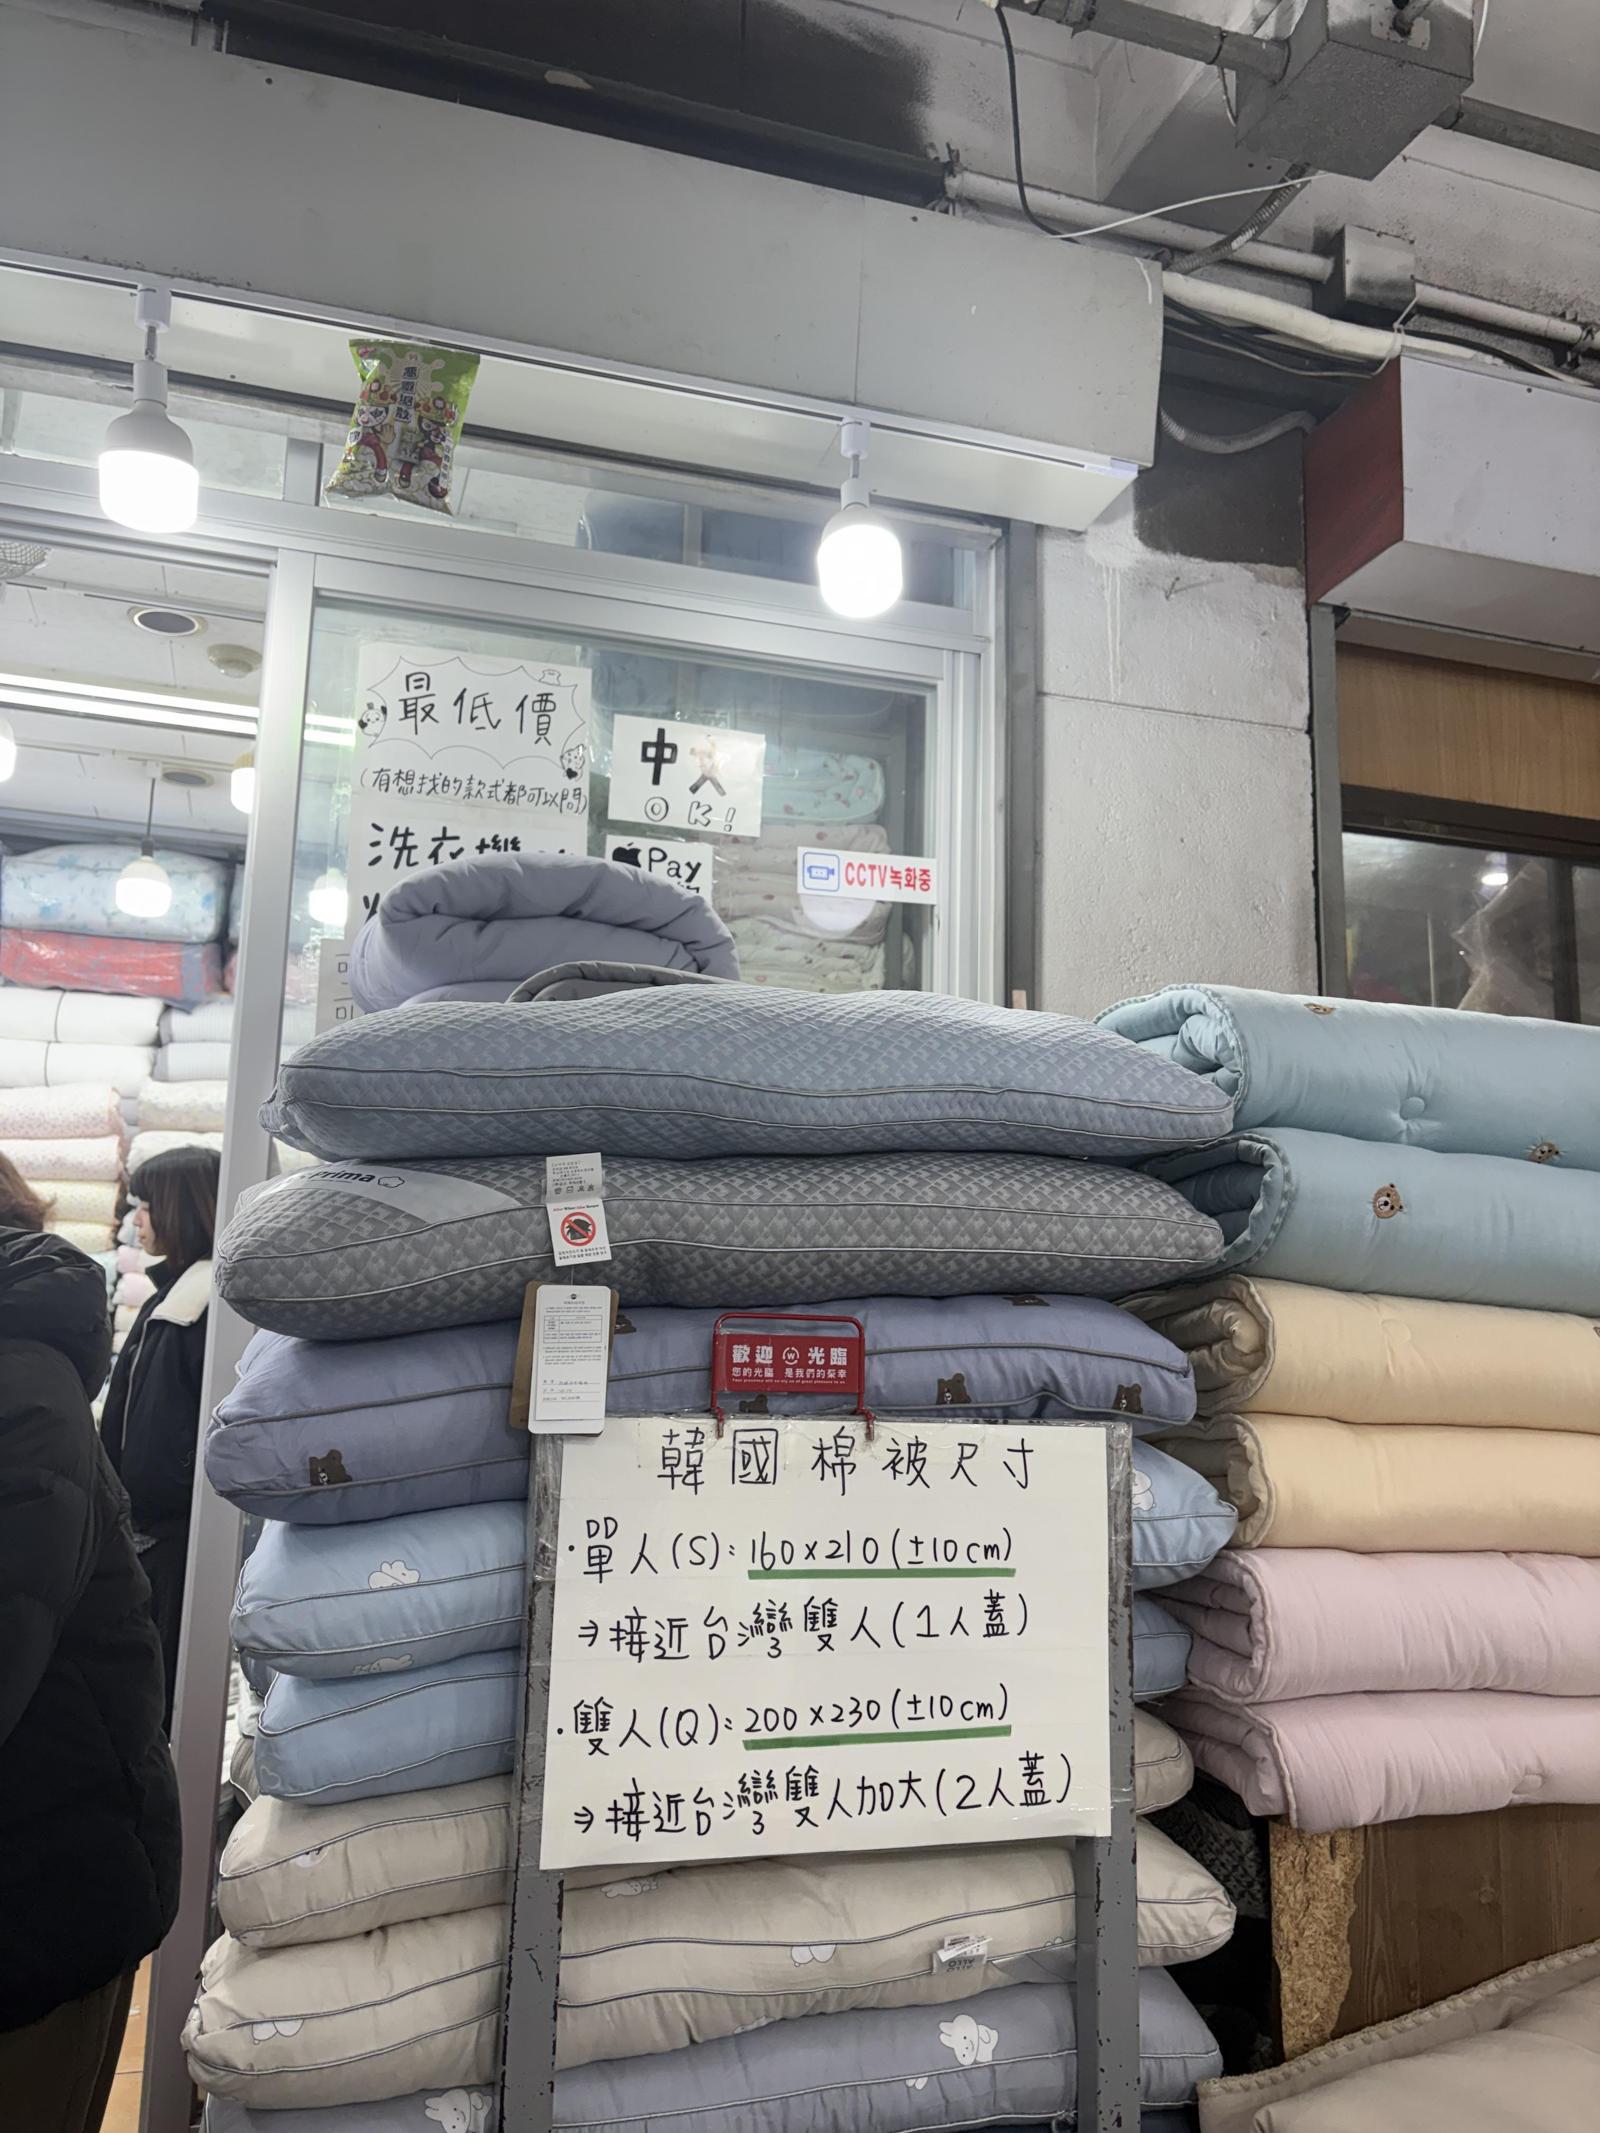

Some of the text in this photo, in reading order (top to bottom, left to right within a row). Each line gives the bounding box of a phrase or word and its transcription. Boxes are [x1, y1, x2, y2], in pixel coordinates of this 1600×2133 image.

[398, 671, 557, 746] 最低價
[641, 727, 727, 797] 中文
[644, 796, 736, 832] OK!
[648, 847, 702, 883] Pay
[732, 1344, 773, 1364] 歡迎
[807, 1346, 848, 1366] 光臨
[657, 1425, 1034, 1497] 韓國棉被尺寸
[609, 1588, 1028, 1663] 接近台灣雙人(1人蓋)
[605, 1750, 1072, 1843] 接近台灣雙人加大(2人蓋)
